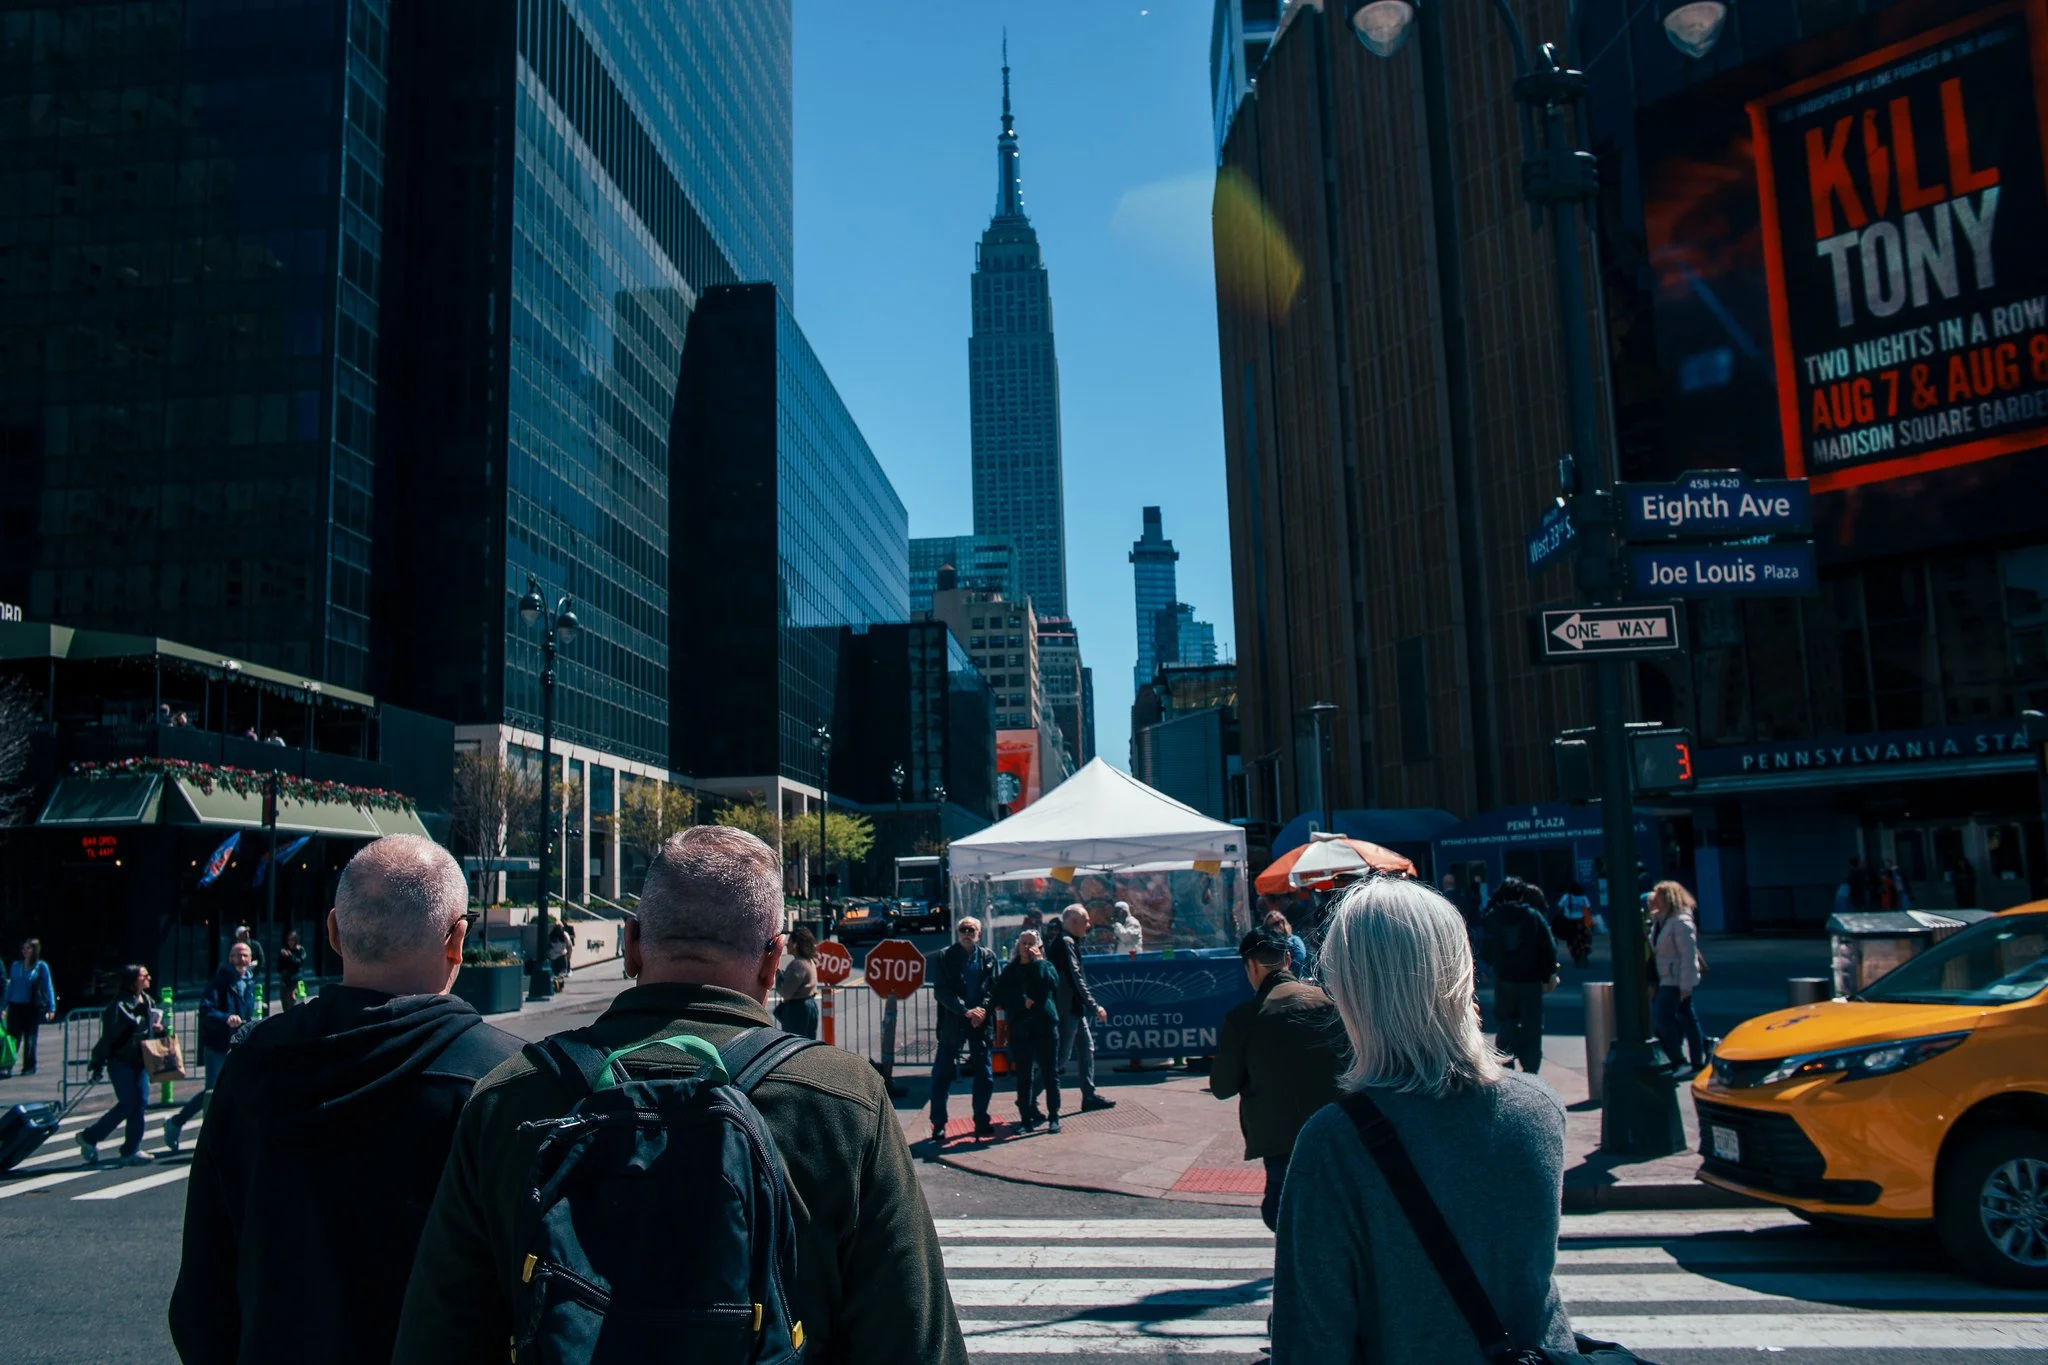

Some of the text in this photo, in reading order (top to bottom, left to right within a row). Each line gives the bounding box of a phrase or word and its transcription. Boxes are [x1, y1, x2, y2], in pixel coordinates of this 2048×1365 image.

[1804, 76, 2000, 240] KILL
[1816, 185, 2002, 328] TONY
[1804, 295, 2048, 385] TWO NIGHTS IN A ROW
[1811, 376, 1875, 434] AUG
[1880, 369, 1901, 418] 7
[1910, 362, 1939, 411] &
[1947, 341, 2021, 403] AUG
[1812, 423, 1896, 466] MADISON
[1899, 405, 1976, 447] SQUARE
[1689, 478, 1740, 490] 458 420
[1642, 492, 1791, 526] Eighth Ave
[1529, 533, 1549, 564] West
[1565, 514, 1575, 539] S
[1649, 557, 1800, 585] Joe Louis Plaza
[1566, 620, 1656, 640] ONE WAY
[1675, 743, 1692, 781] 3
[1741, 736, 1960, 771] PENNSYLVANIA
[1506, 816, 1566, 831] PENN PLAZA
[869, 957, 922, 982] STOP
[1162, 1012, 1184, 1025] TO
[1105, 1027, 1218, 1050] GARDEN
